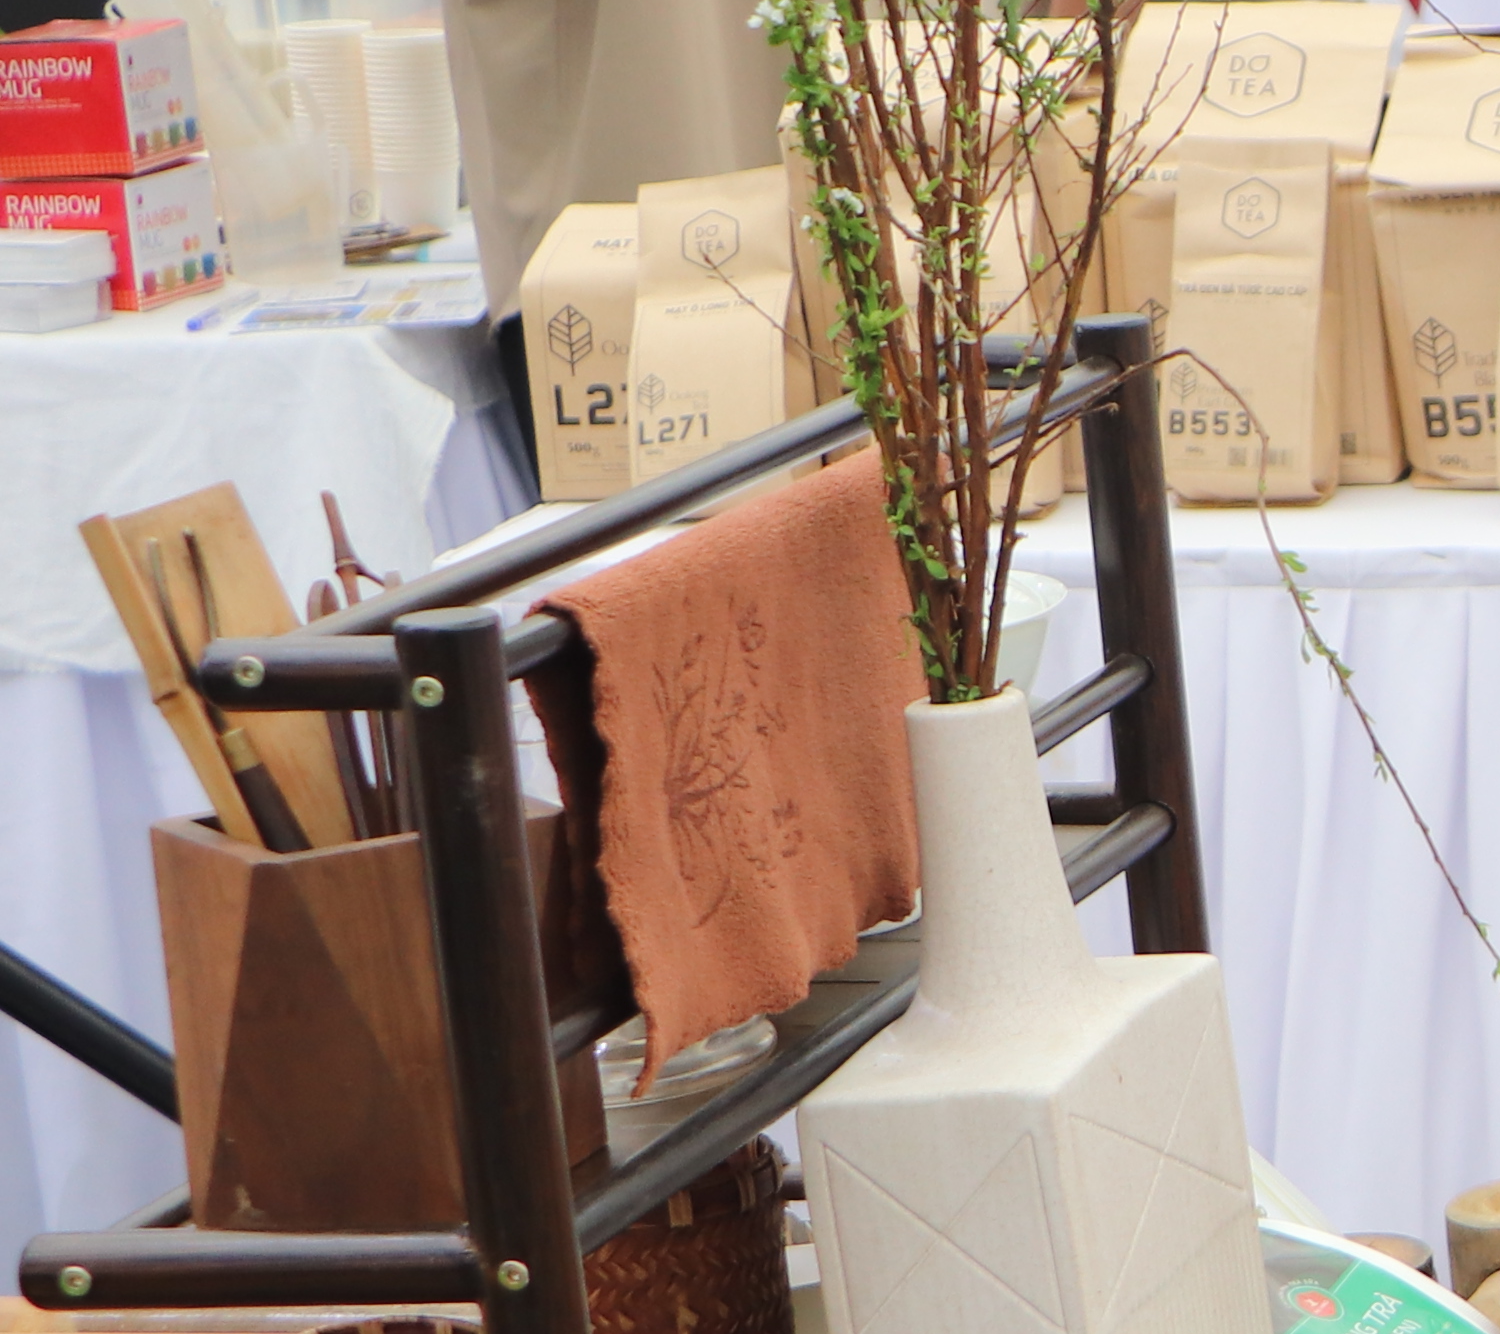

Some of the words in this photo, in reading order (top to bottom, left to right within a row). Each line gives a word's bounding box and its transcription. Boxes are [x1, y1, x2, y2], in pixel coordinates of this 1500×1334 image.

[1229, 77, 1277, 96] TEA
[6, 194, 101, 216] RAINBOW
[1237, 210, 1266, 222] TEA
[8, 215, 53, 230] MUG
[638, 413, 710, 447] L271
[1168, 409, 1252, 437] B553
[1363, 1291, 1405, 1326] TRÀ
